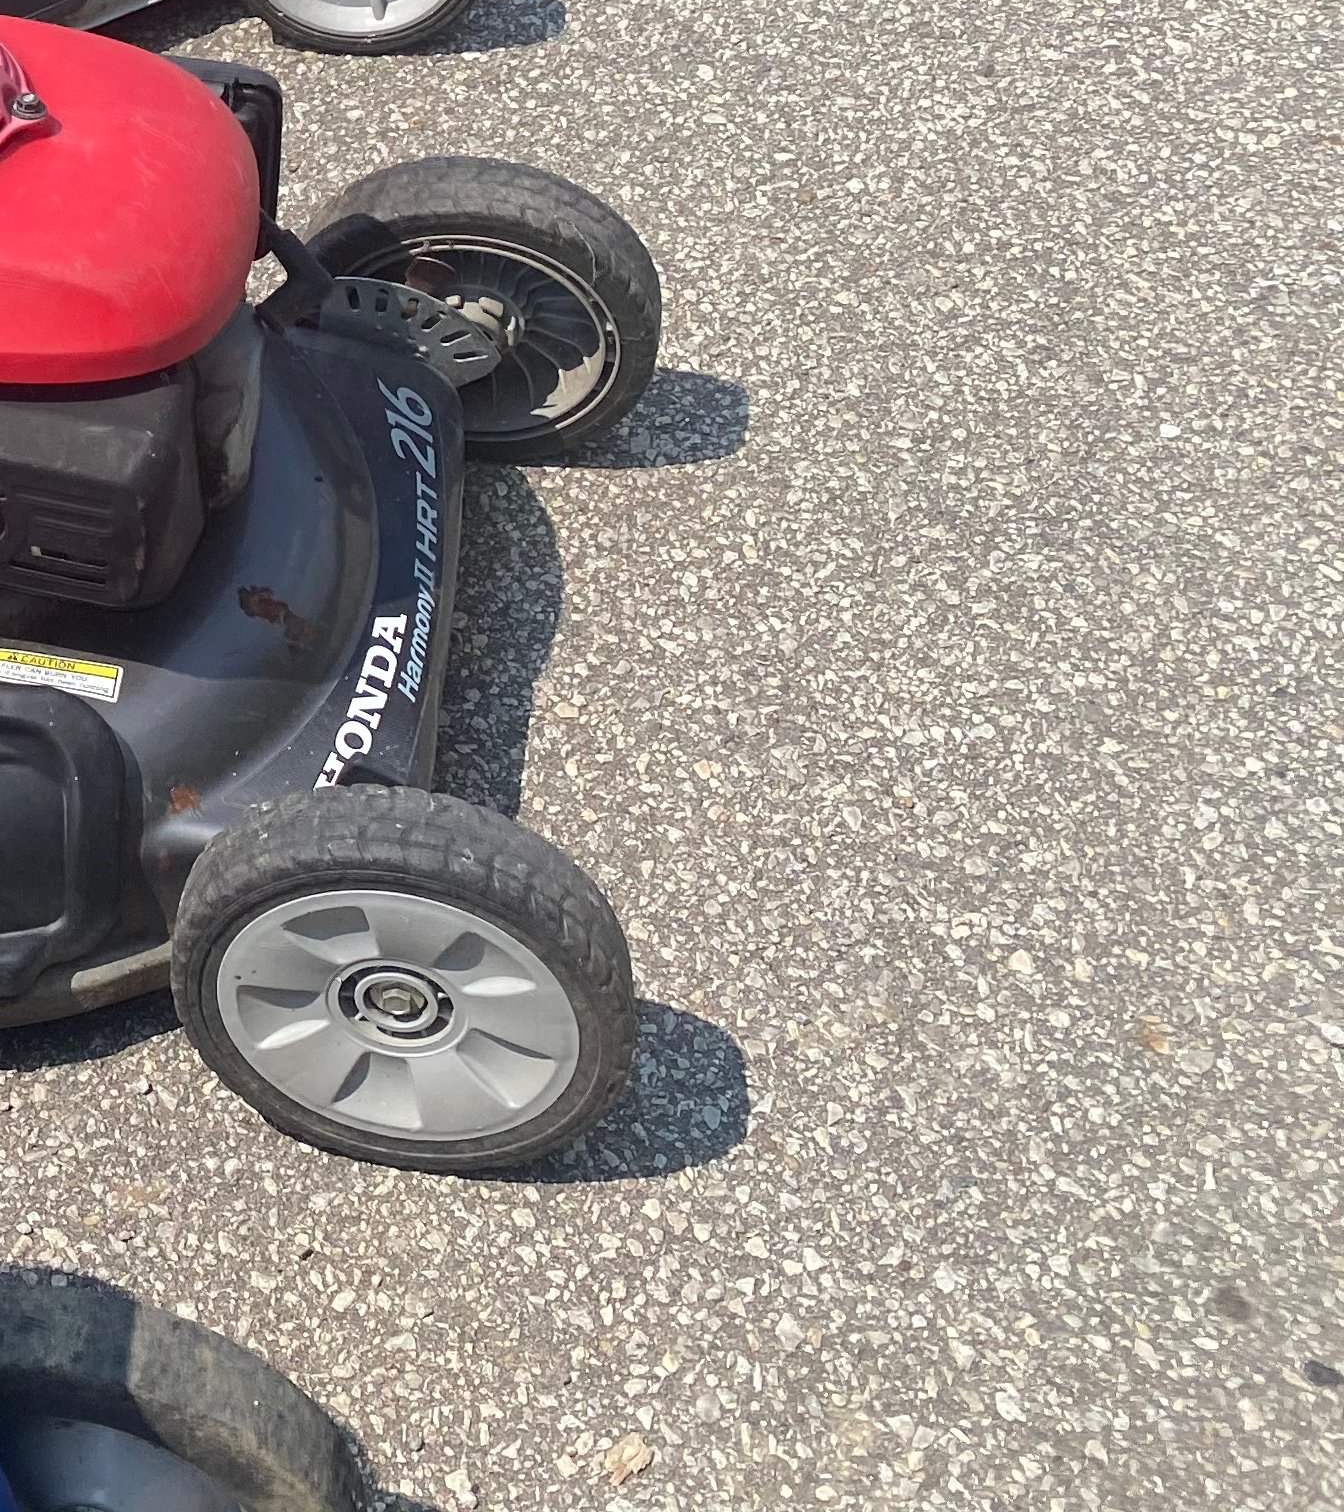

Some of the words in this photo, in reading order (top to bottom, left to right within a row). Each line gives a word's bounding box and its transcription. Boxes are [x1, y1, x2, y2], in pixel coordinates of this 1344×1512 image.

[377, 377, 435, 479] 216
[416, 470, 438, 561] HRT
[20, 655, 75, 670] CAUTION
[24, 666, 41, 674] CAN
[44, 670, 66, 678] BURN
[395, 583, 441, 702] Harmony
